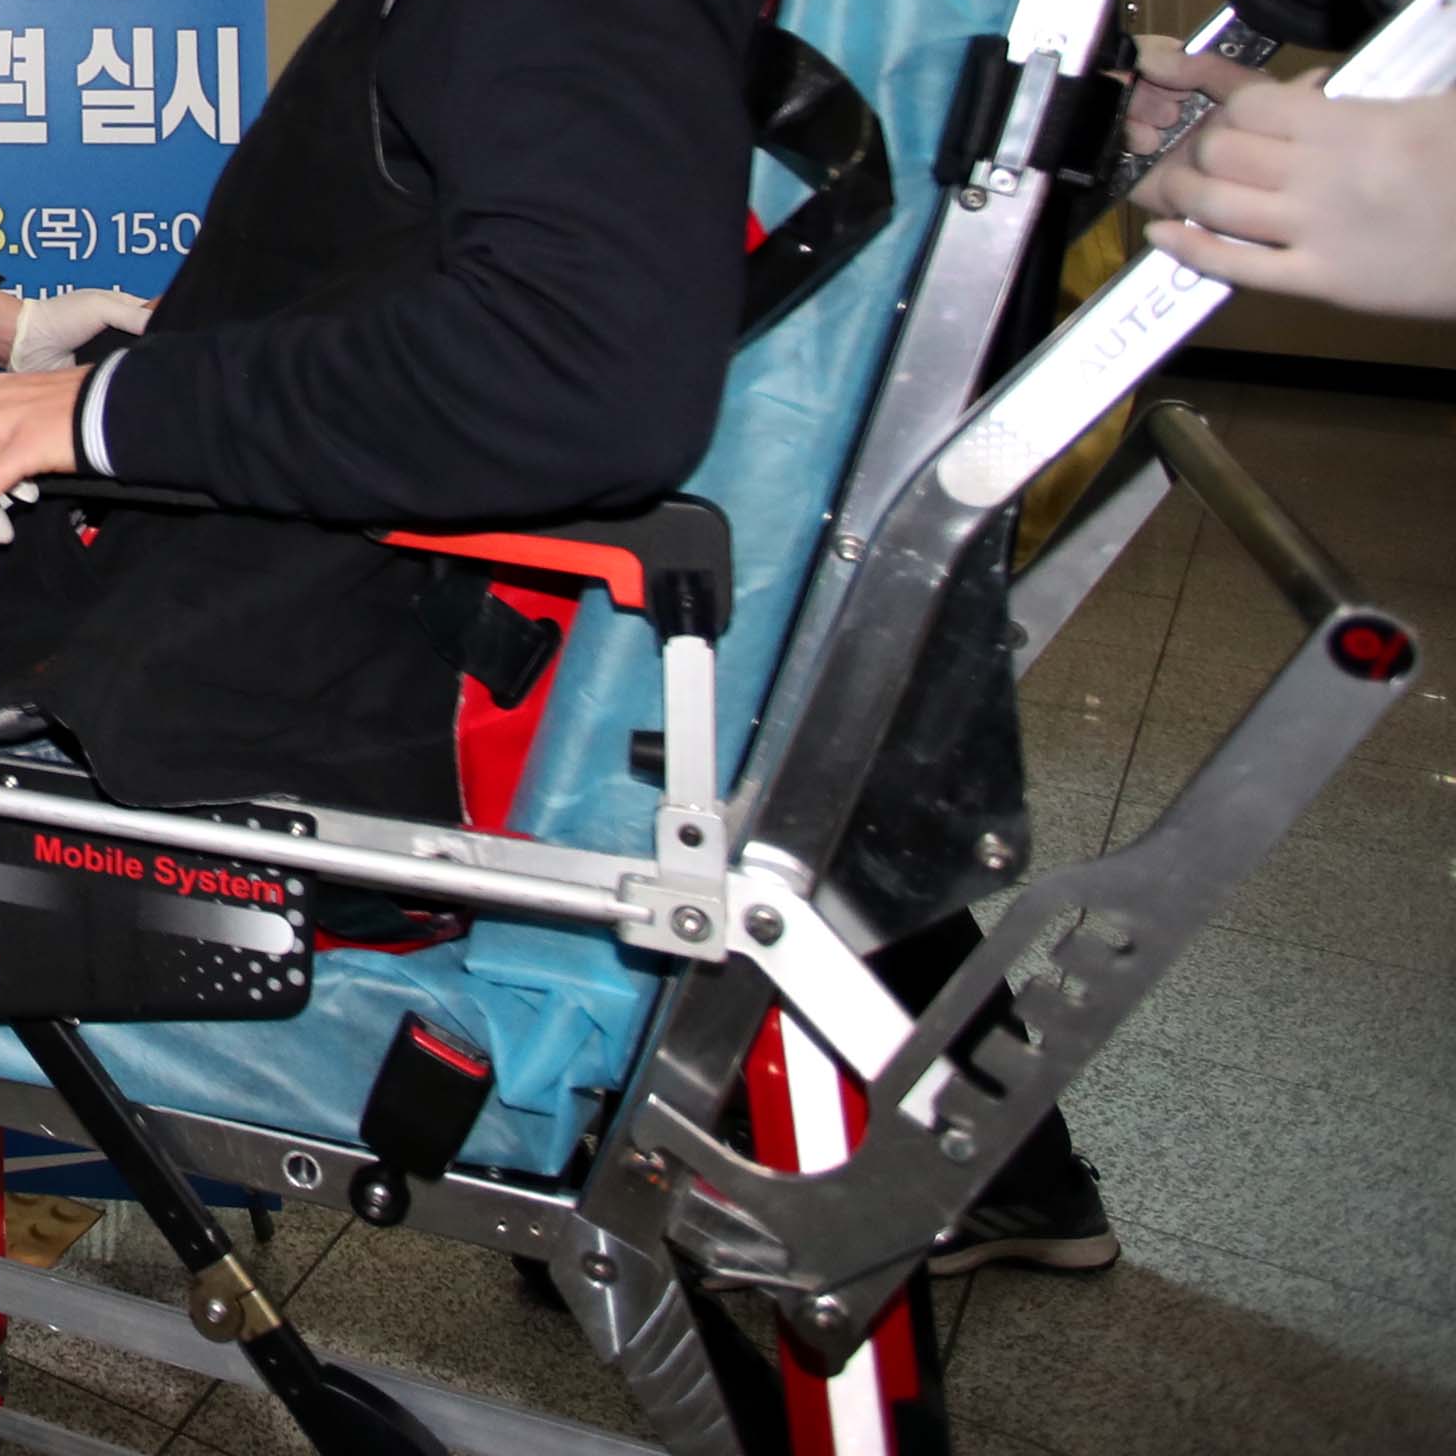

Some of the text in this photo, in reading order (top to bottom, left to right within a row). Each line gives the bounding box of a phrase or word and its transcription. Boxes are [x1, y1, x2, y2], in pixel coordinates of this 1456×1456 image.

[76, 26, 242, 144] 실시
[33, 833, 284, 905] Mobile System
